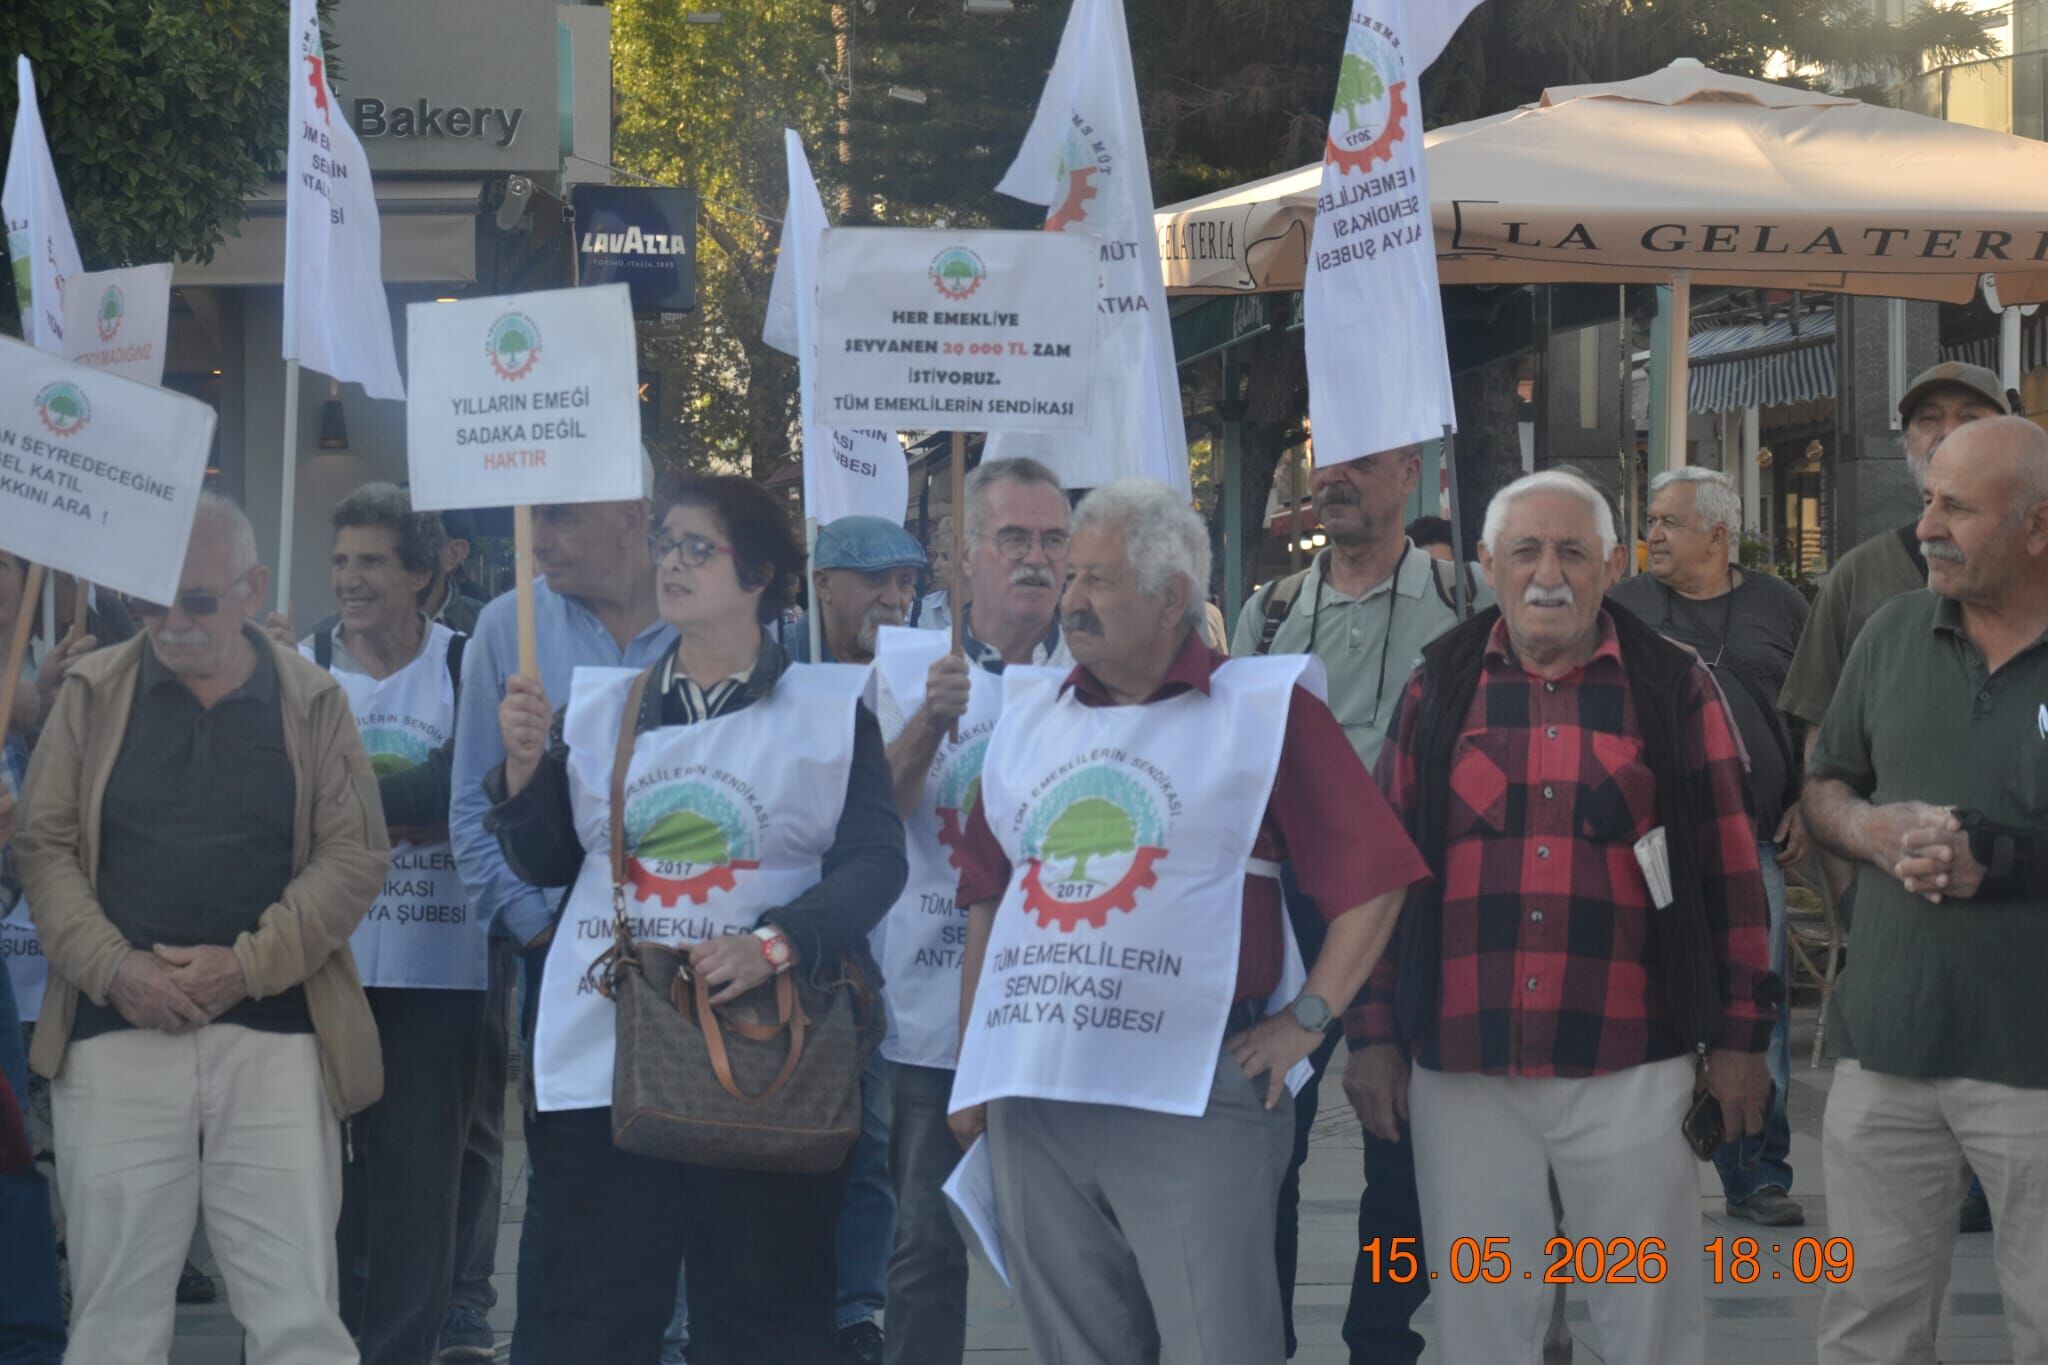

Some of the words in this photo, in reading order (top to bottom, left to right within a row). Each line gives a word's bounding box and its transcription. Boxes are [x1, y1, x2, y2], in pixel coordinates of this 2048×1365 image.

[354, 97, 523, 147] Bakery
[581, 226, 686, 255] LAVAZZA
[1502, 221, 1603, 250] LA
[892, 310, 928, 326] HER
[933, 311, 1019, 327] EMEKLİYE
[844, 338, 939, 354] SEYYANEN
[968, 343, 1004, 356] 000
[1008, 342, 1028, 356] TL
[1032, 342, 1072, 357] ZAM
[908, 366, 1001, 386] İSTİYORUZ.
[452, 394, 527, 416] YILLARIN
[532, 386, 590, 410] EMEĞİ
[833, 393, 870, 411] TÜM
[873, 393, 983, 413] EMEKLİLERİN
[987, 397, 1074, 415] SENDİKASI
[456, 425, 527, 446] SADAKA
[531, 417, 587, 441] DEĞİL
[0, 430, 17, 446] N
[20, 436, 176, 502] SEYREDECEĞİNE
[0, 452, 25, 475] EL
[29, 461, 83, 493] KATIL
[484, 449, 547, 470] HAKTIR
[51, 495, 92, 520] ARA
[655, 861, 693, 875] 2017
[1056, 883, 1094, 899] 2017
[397, 903, 467, 925] ŞUBESİ
[993, 946, 1019, 974] TÜM
[1022, 941, 1183, 977] EMEKLİLERİN
[1005, 971, 1123, 1001] SENDİKASI
[984, 1003, 1065, 1030] ANTALYA
[1072, 1004, 1165, 1034] ŞUBESİ
